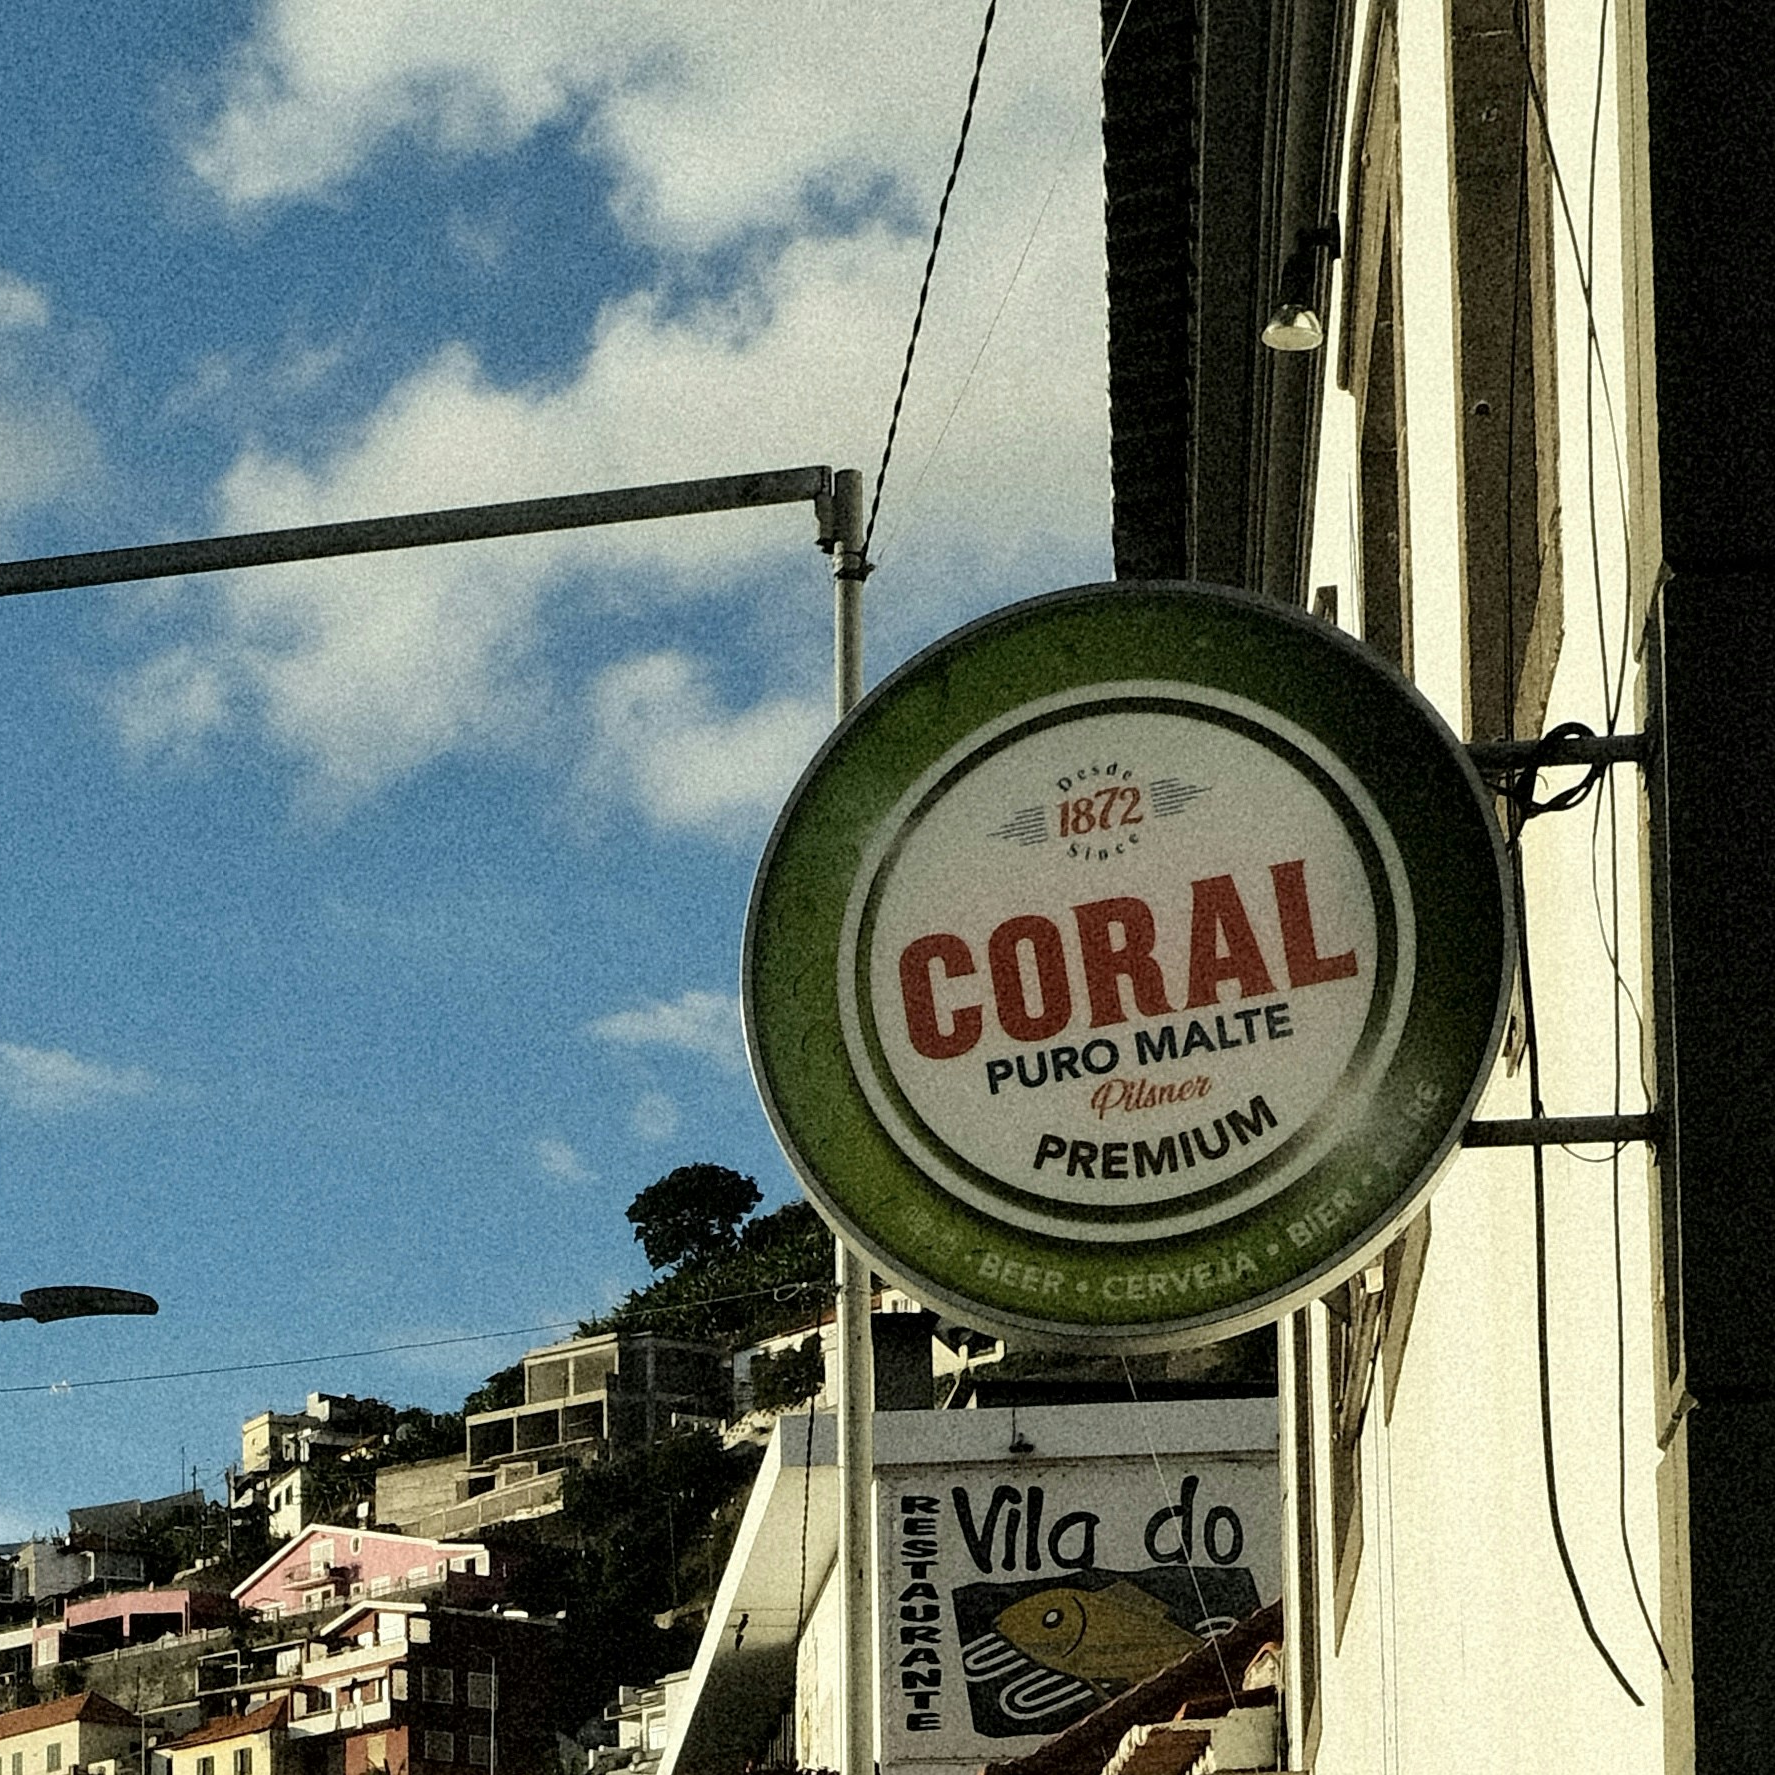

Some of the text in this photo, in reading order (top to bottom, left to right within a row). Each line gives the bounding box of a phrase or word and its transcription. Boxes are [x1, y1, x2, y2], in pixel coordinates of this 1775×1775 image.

[1056, 761, 1133, 793] Desde
[1056, 786, 1144, 838] 1872
[1067, 833, 1139, 861] Since
[899, 858, 1359, 1060] CORAL
[986, 1002, 1294, 1095] PURO MALTE
[1033, 1094, 1279, 1180] PREMIUM
[1091, 1072, 1213, 1120] Pilsner
[977, 1252, 1065, 1296] BEER
[1102, 1249, 1259, 1302] CERVEJA
[1286, 1188, 1360, 1248] BIER
[951, 1475, 1243, 1574] Vila do
[899, 1495, 942, 1731] RESTAURANTE
